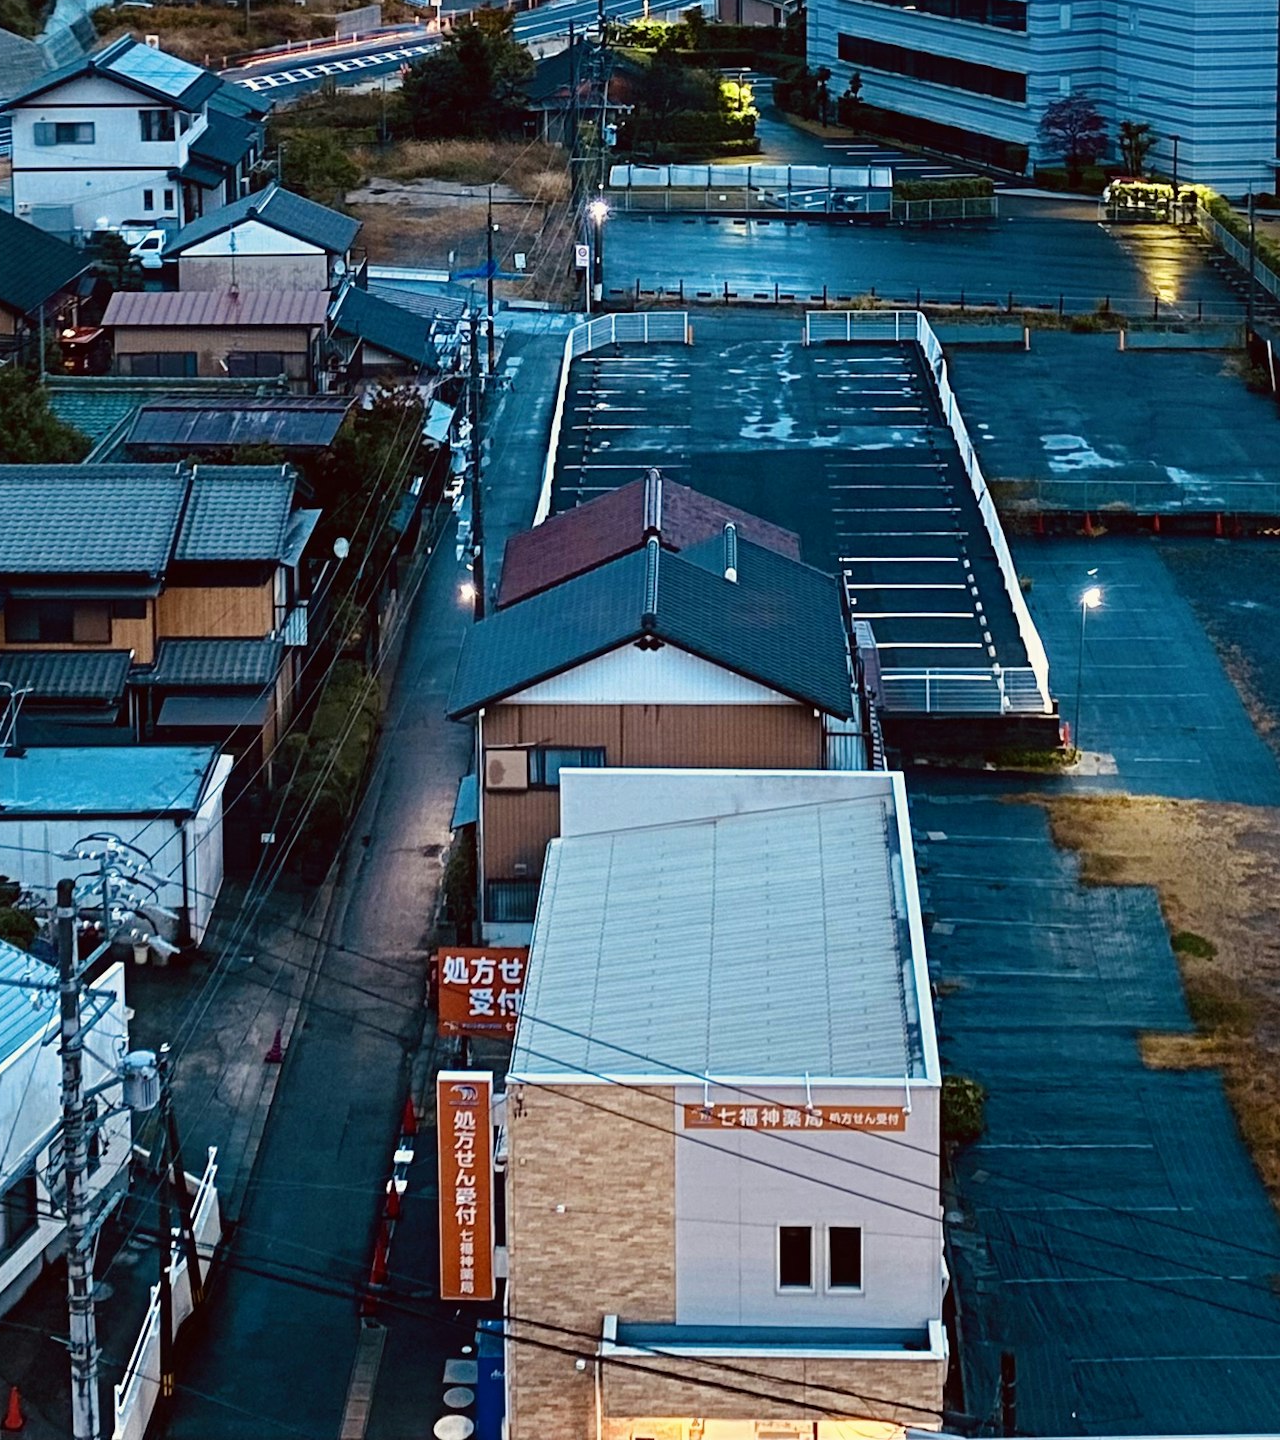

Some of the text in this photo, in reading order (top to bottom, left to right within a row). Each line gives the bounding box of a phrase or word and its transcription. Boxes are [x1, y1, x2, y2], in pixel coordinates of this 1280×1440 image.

[442, 955, 524, 985] 処方せ
[468, 987, 522, 1016] 受付
[717, 1107, 900, 1128] 七福神薬局 処方せん受付
[453, 1110, 477, 1226] 処方せん受付
[459, 1229, 475, 1294] 七福神薬局
